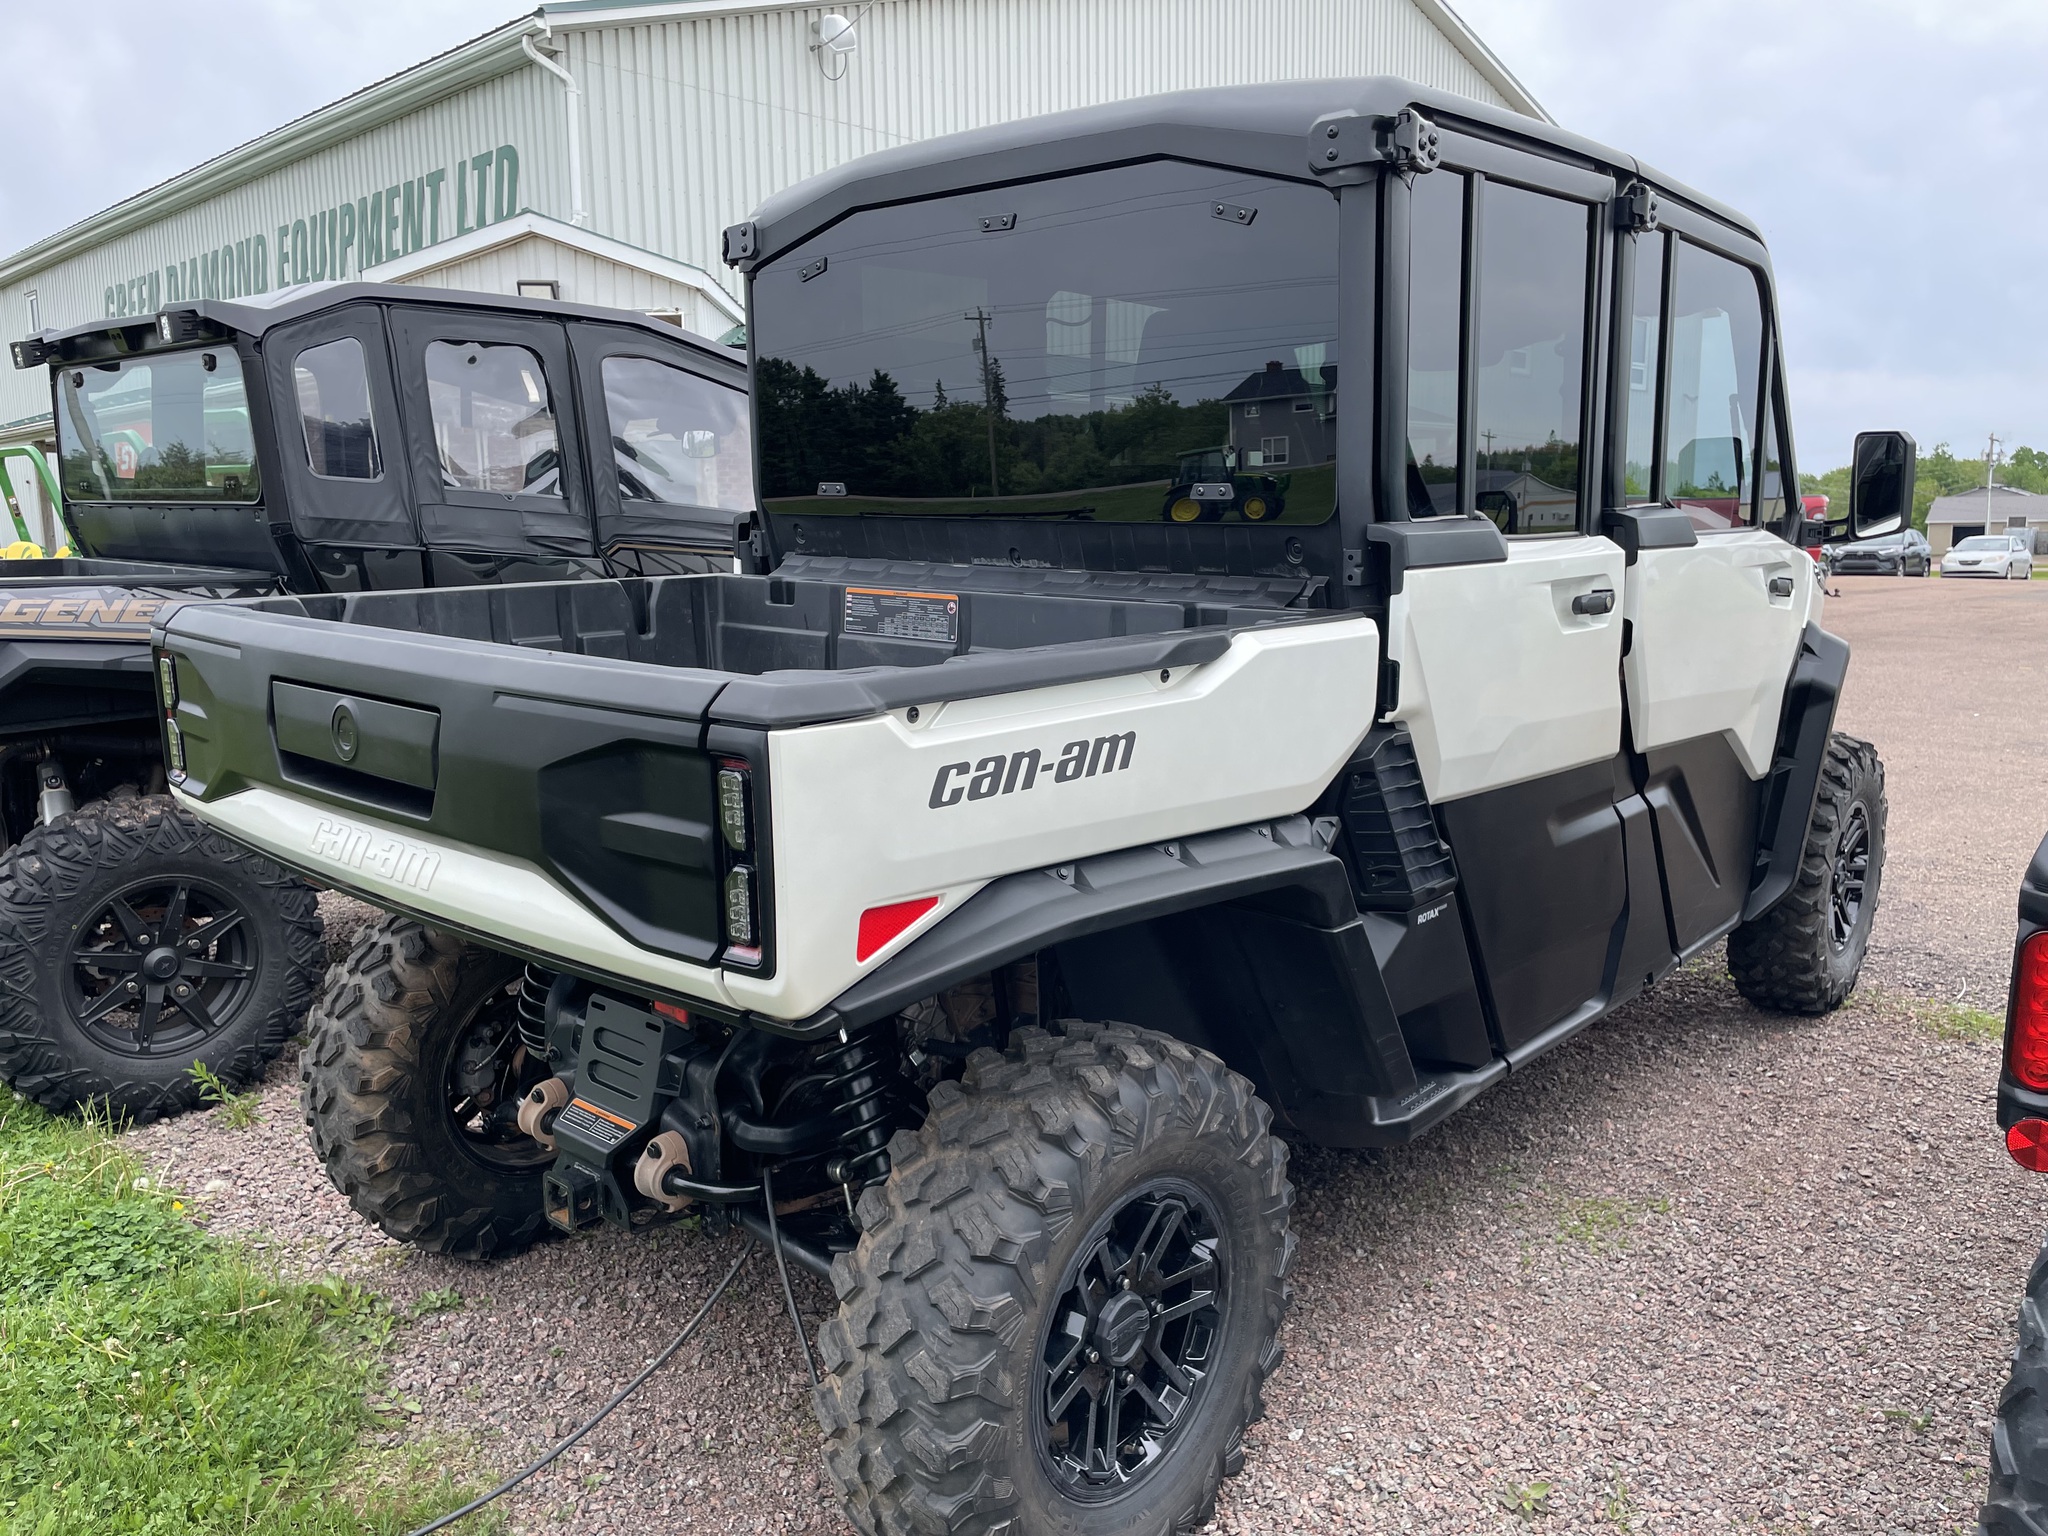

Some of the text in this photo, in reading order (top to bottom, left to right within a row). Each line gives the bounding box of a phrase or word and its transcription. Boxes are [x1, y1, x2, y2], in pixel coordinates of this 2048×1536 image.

[104, 143, 520, 318] GREEN DIAMOND EQUIPMENT LTD
[928, 730, 1137, 810] can-am
[307, 815, 442, 892] can-am
[1417, 907, 1439, 925] ROTAX
